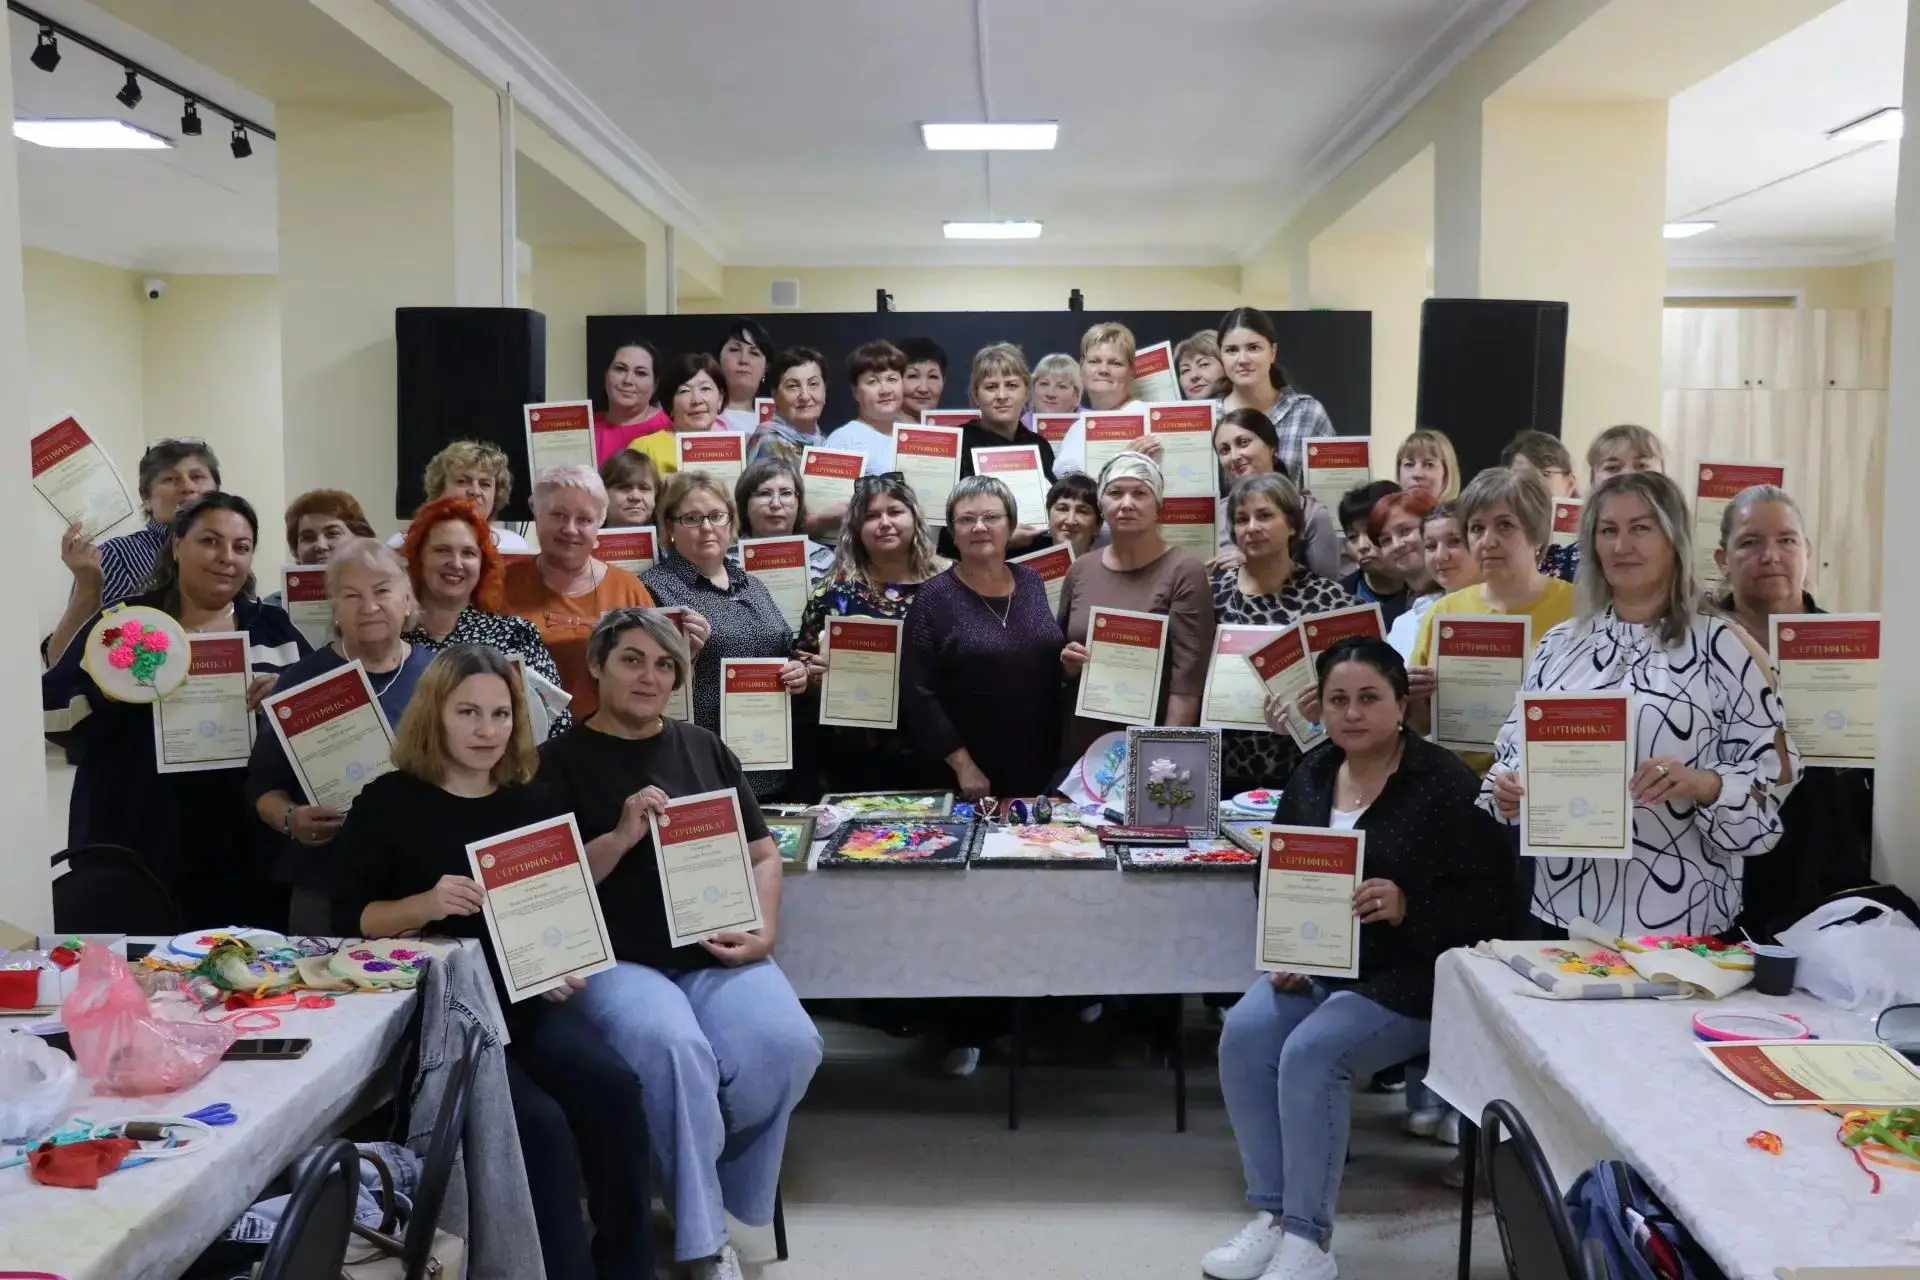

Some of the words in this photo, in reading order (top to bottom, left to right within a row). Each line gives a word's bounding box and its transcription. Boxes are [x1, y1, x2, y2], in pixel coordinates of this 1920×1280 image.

[904, 444, 949, 454] СЕРТИФИКАТ
[690, 451, 733, 460] СЕРТИФИКАТ
[1791, 644, 1868, 655] СЕРТИФИКАТ
[1538, 724, 1613, 736] СЕРТИФИКАТ
[669, 820, 726, 838] СЕРТИФИКАТ
[494, 851, 565, 879] СЕРТИФИКАТ
[1279, 856, 1345, 868] СЕРТИФИКАТ
